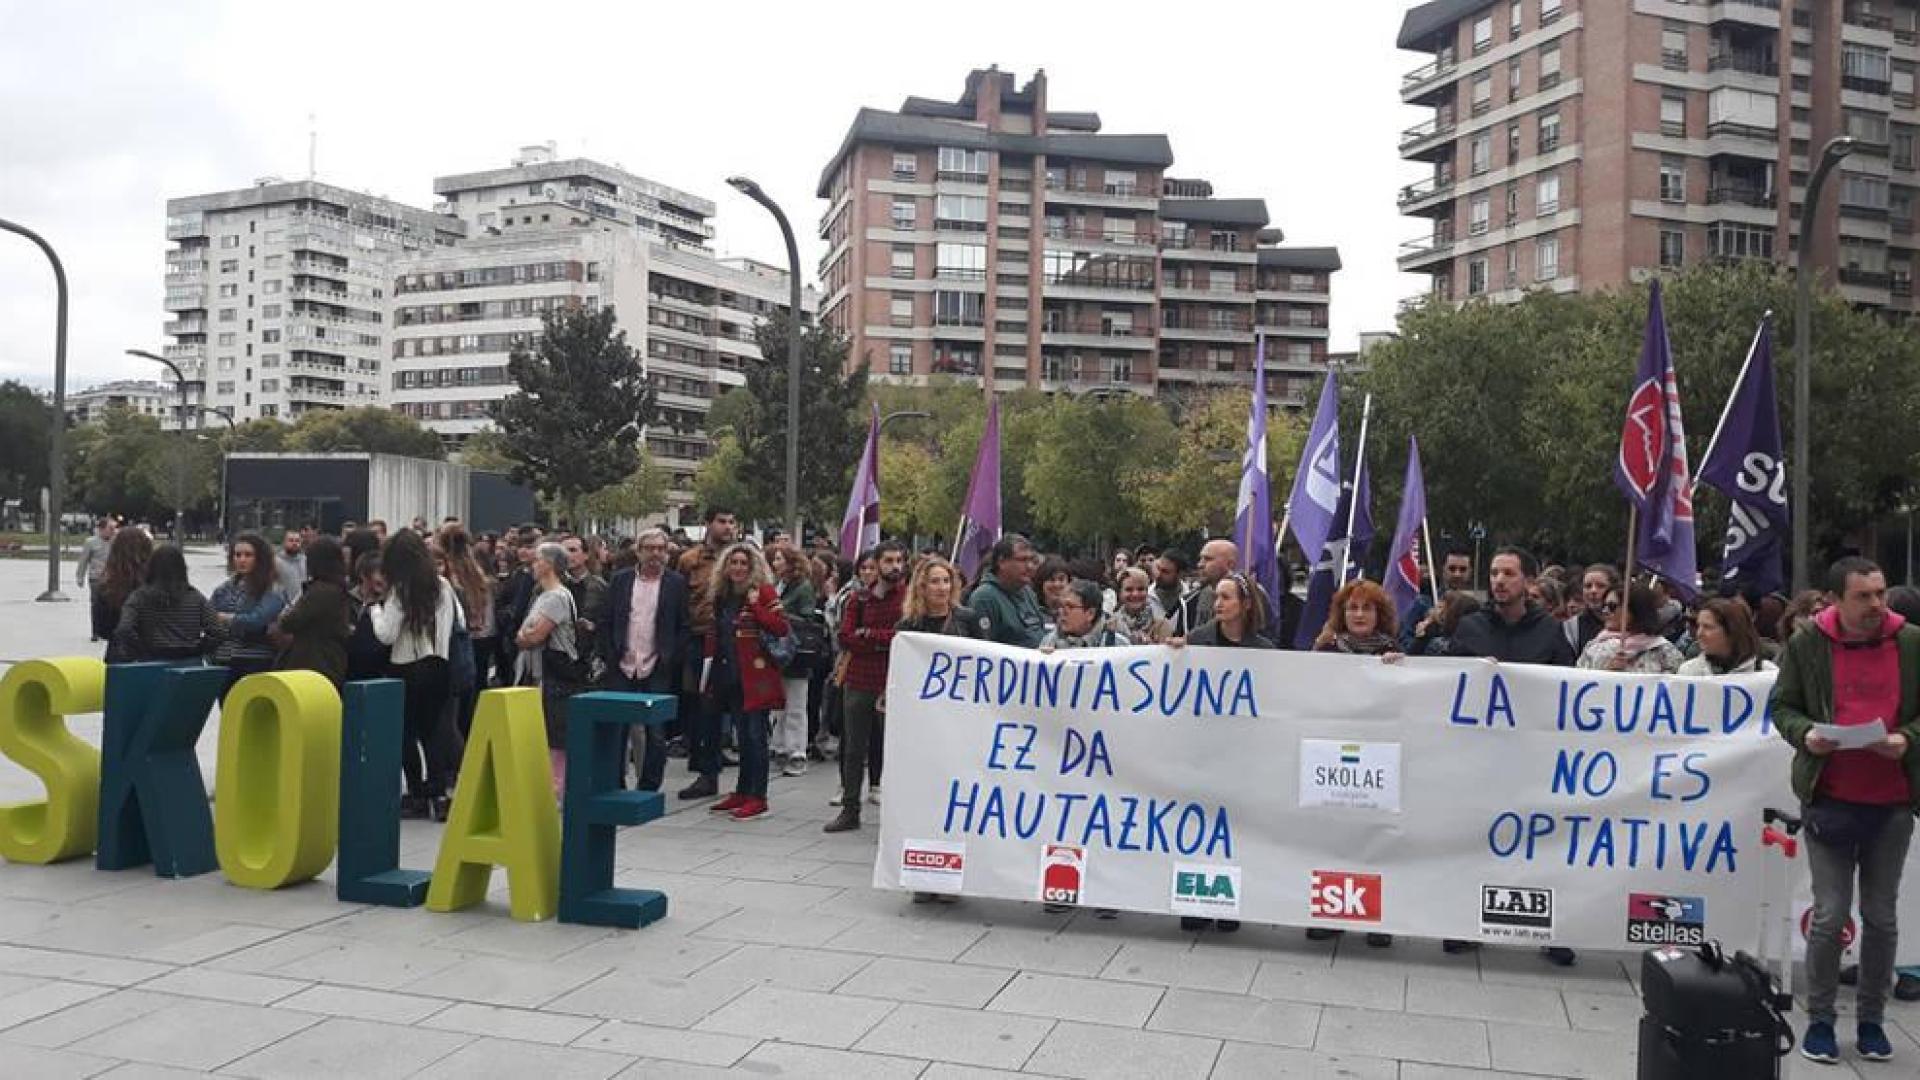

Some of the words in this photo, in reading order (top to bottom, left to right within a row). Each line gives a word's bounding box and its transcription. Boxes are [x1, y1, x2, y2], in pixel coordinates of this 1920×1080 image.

[920, 652, 1258, 717] BERDINTASUNA
[1450, 672, 1515, 728] LA
[1557, 681, 1775, 736] IGUALD
[986, 723, 1037, 770] EZ
[1059, 728, 1113, 777] DA
[1551, 749, 1618, 797] NO
[1650, 752, 1711, 801] ES
[0, 657, 677, 929] SKOLAE
[1315, 766, 1385, 789] SKOLAE
[943, 780, 1233, 858] HAUTAZKOA
[1488, 812, 1738, 873] OPTATIVA
[1046, 887, 1077, 903] CGT
[1177, 871, 1235, 898] ELA
[1486, 889, 1547, 914] LAB
